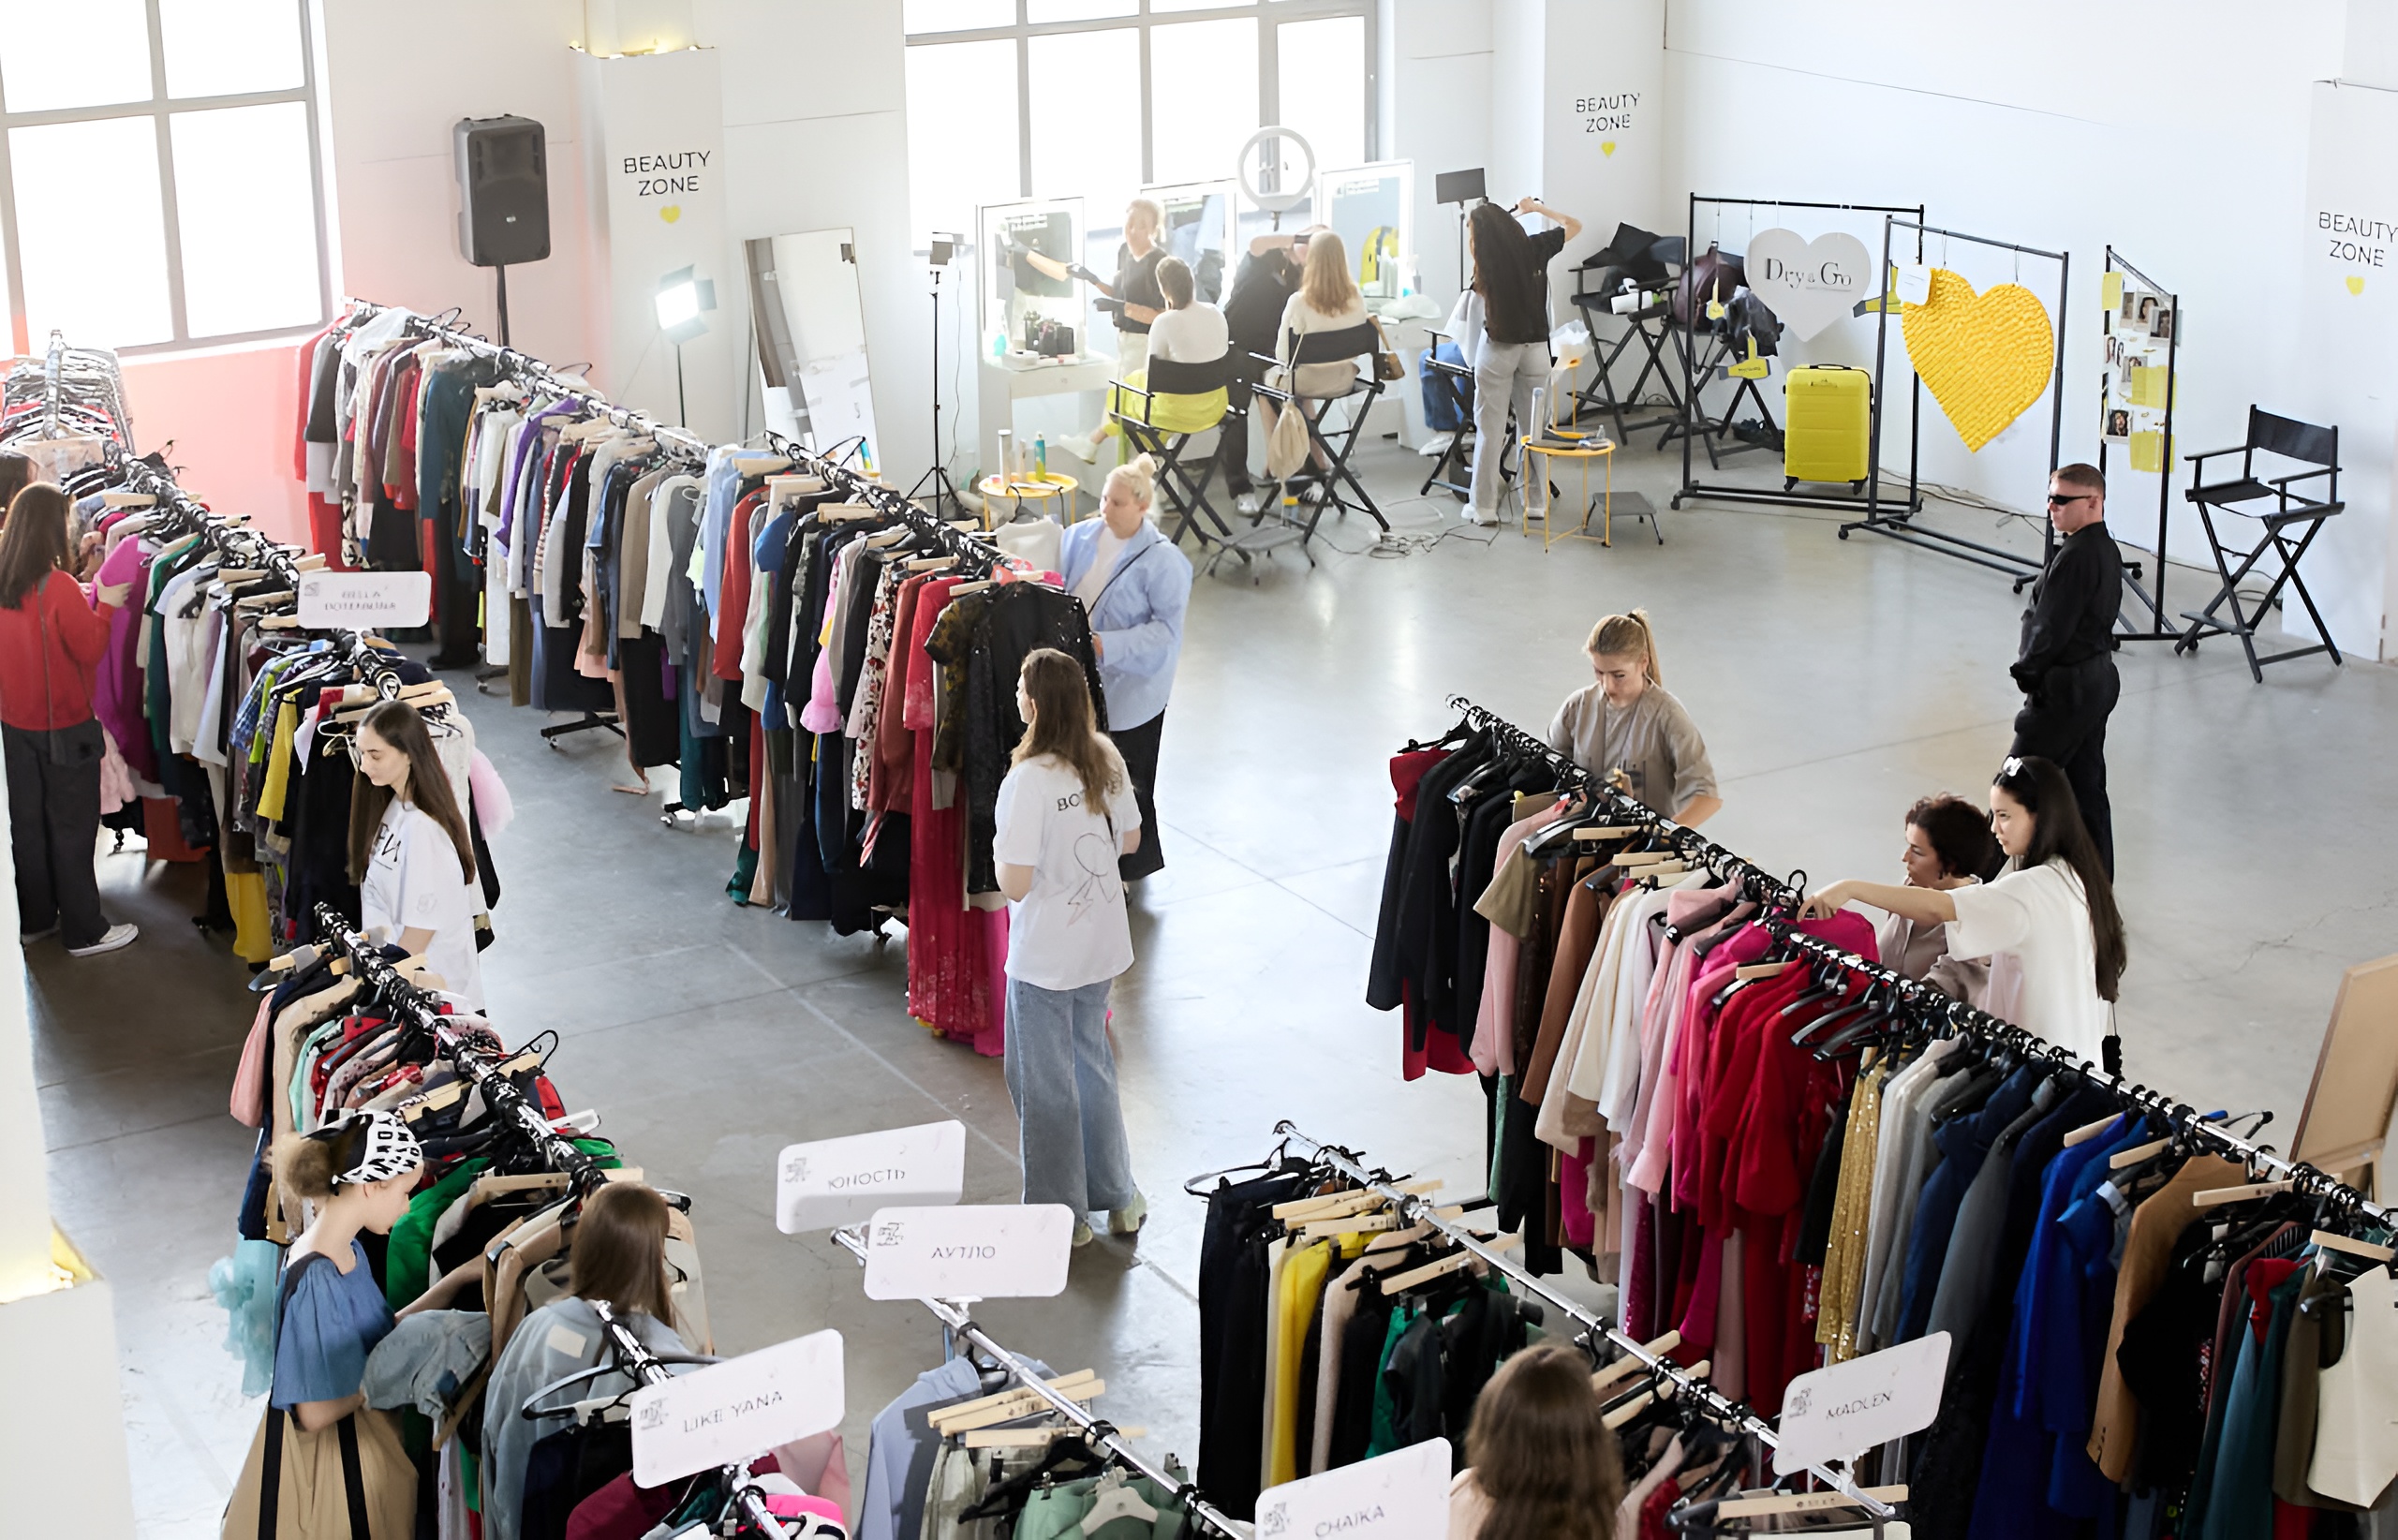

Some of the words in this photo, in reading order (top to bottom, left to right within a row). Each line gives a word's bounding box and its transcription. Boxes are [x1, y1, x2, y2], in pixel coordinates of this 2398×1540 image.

[1576, 92, 1640, 112] BEAUTY
[1586, 113, 1631, 132] ZONE
[624, 150, 711, 173] BEAUTY
[638, 175, 700, 196] ZONE
[2318, 211, 2398, 244] BEAUTY
[2330, 239, 2385, 267] ZONE
[1765, 258, 1805, 289] Dry
[1820, 261, 1852, 287] Go
[731, 1390, 783, 1418] YANA
